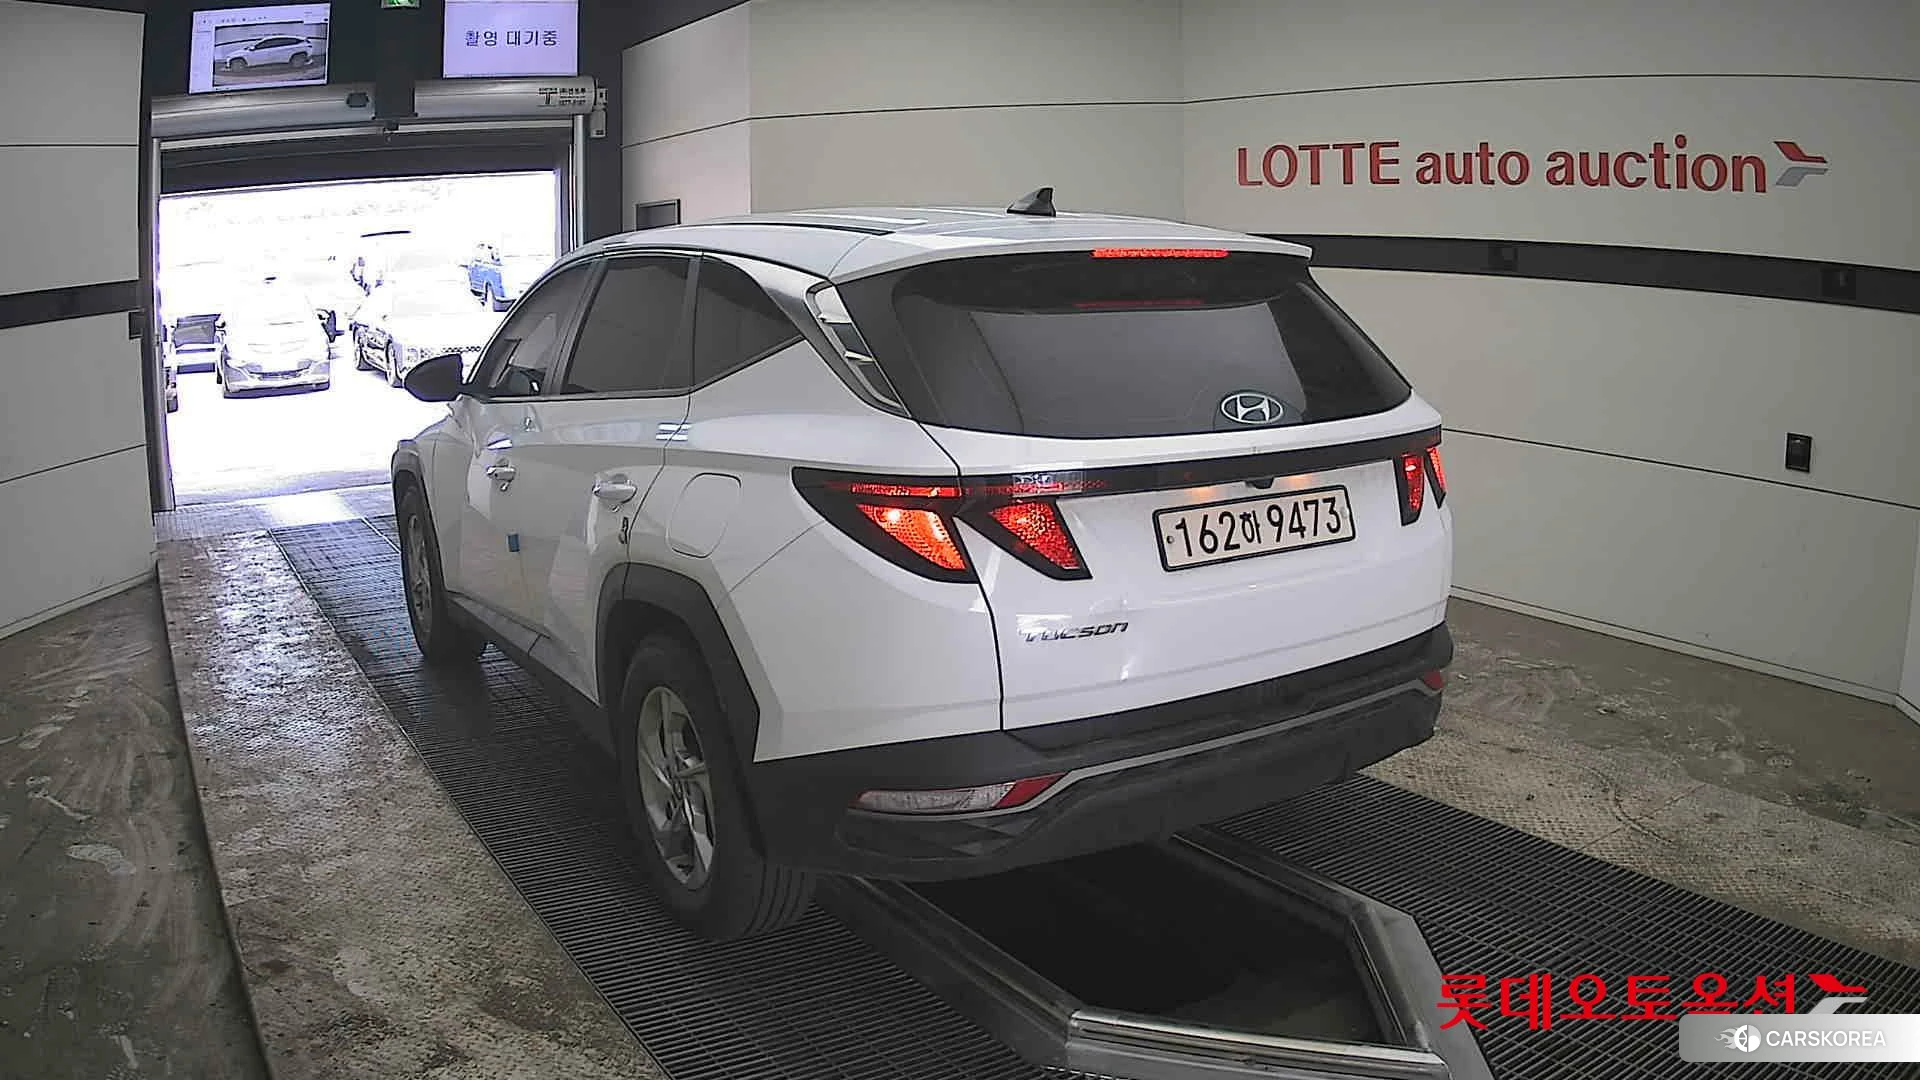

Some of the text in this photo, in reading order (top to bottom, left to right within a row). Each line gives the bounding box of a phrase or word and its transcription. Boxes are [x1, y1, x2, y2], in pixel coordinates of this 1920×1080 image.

[506, 30, 557, 46] 대기중
[1237, 135, 1767, 193] LOTTE auto auction
